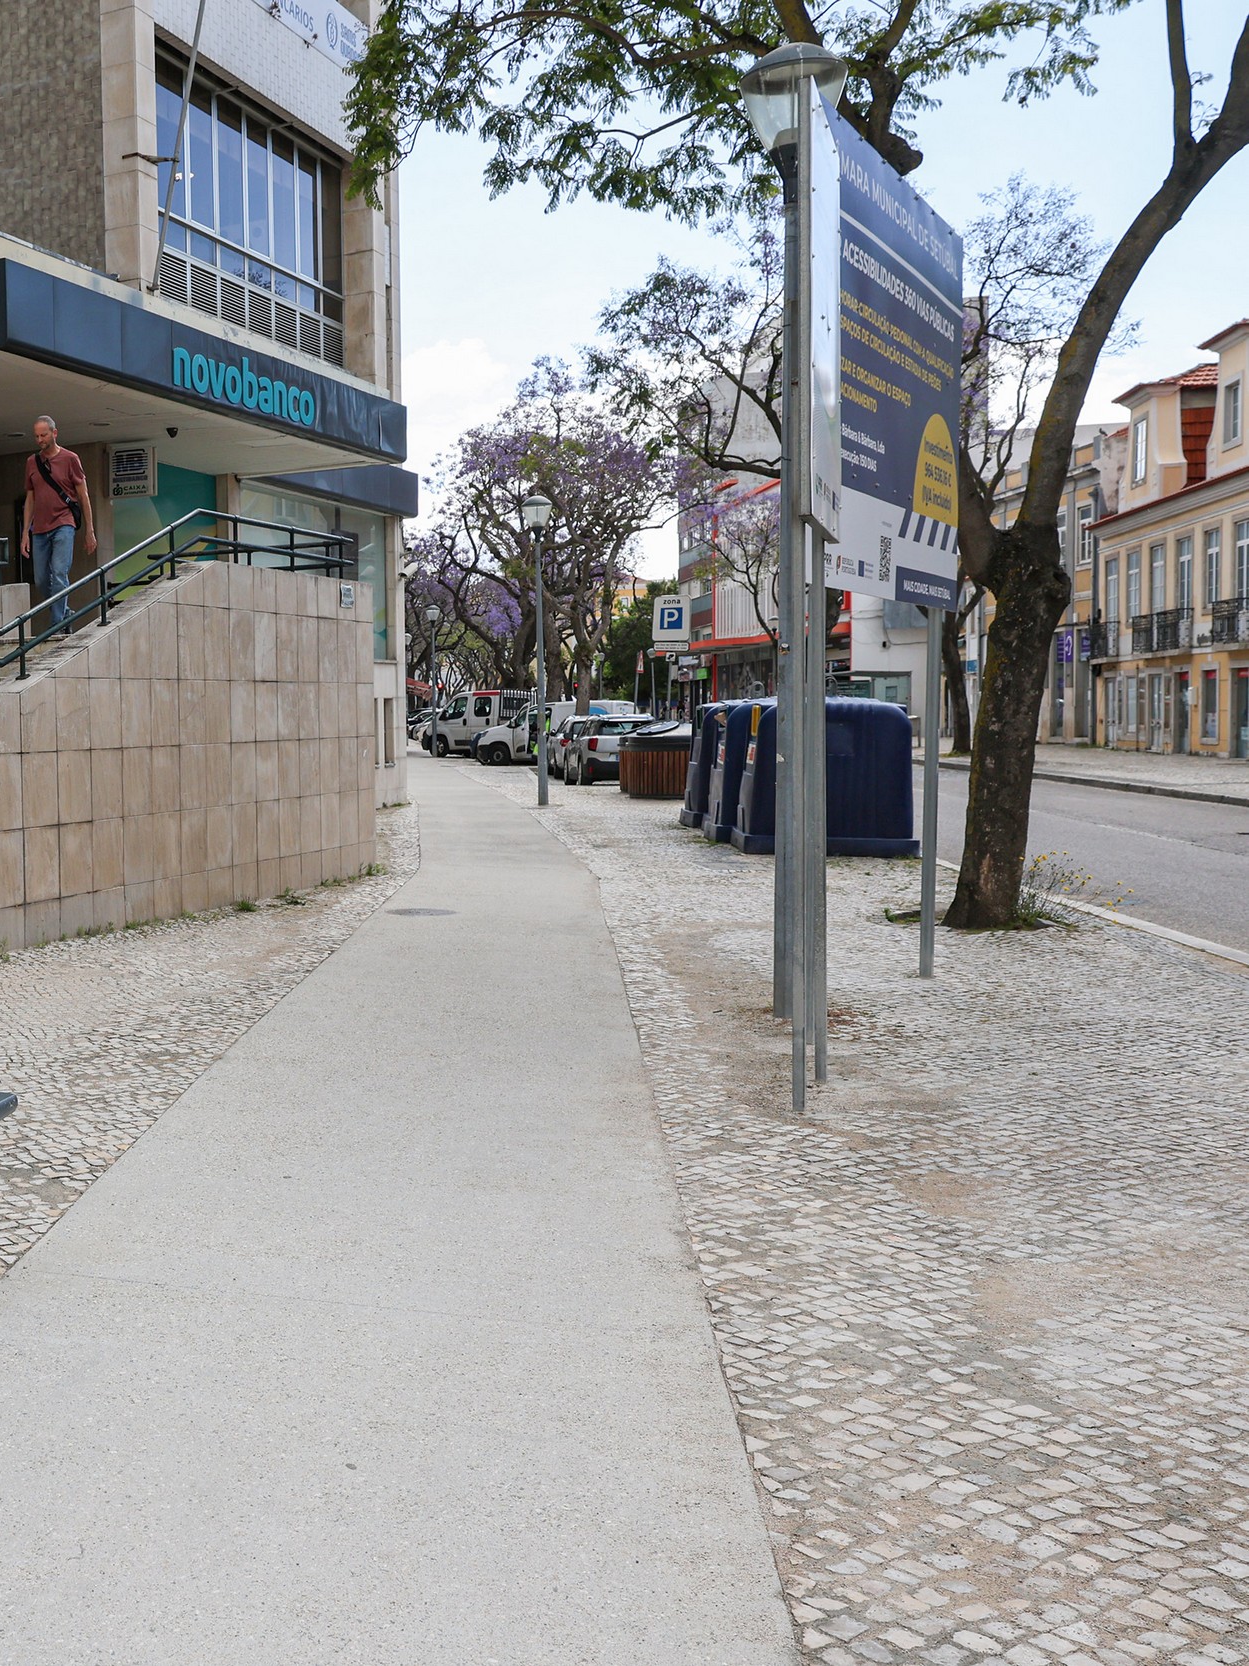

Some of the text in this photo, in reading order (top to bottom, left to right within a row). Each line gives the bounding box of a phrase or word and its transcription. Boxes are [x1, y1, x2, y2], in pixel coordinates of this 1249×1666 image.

[836, 140, 958, 281] MARA MUNICIPAL DE SETÚBAL
[842, 238, 904, 302] ACESSIBILIDADES
[929, 305, 955, 342] PÚBLICAS
[861, 328, 869, 345] DE
[172, 346, 315, 426] novobanco
[664, 608, 679, 629] P
